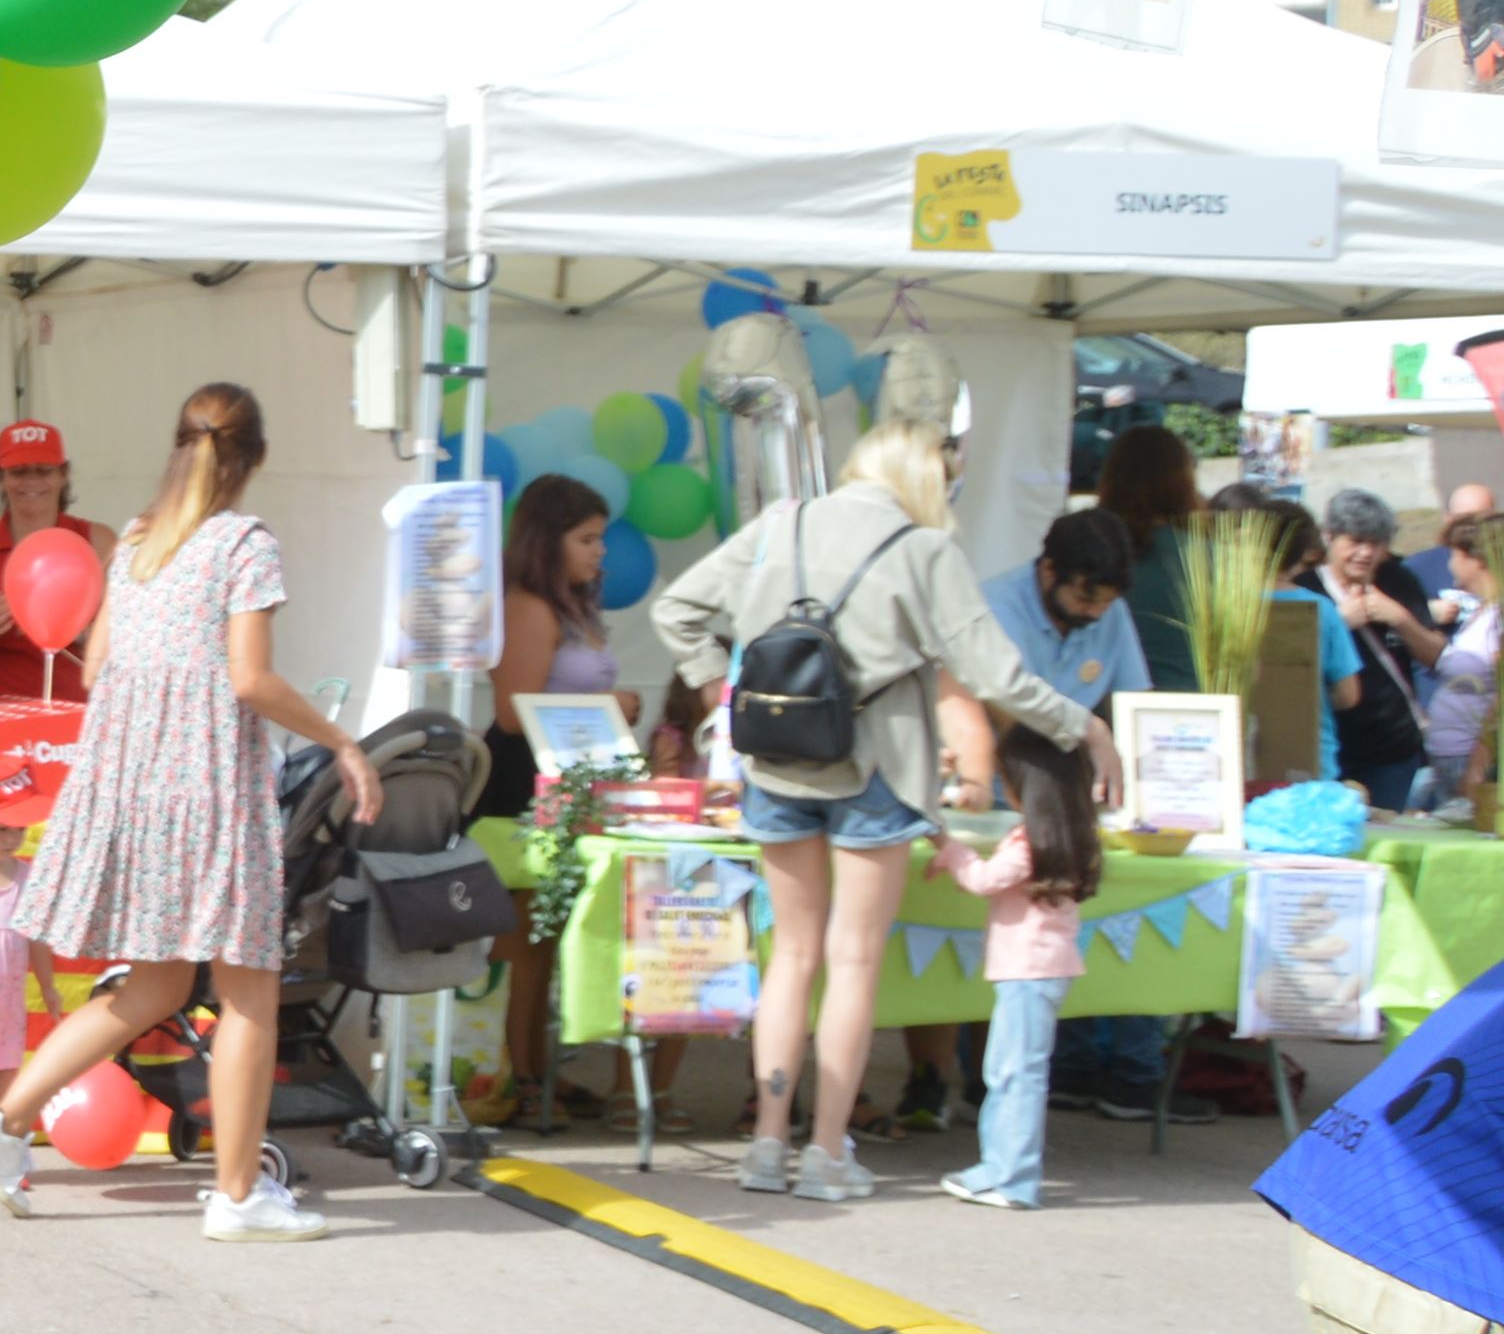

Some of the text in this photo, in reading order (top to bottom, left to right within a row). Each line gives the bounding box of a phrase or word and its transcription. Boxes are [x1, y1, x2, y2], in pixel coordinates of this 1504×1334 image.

[933, 163, 1006, 189] LA FESTA
[1114, 191, 1228, 216] SINAPSIS
[11, 425, 49, 444] TOT
